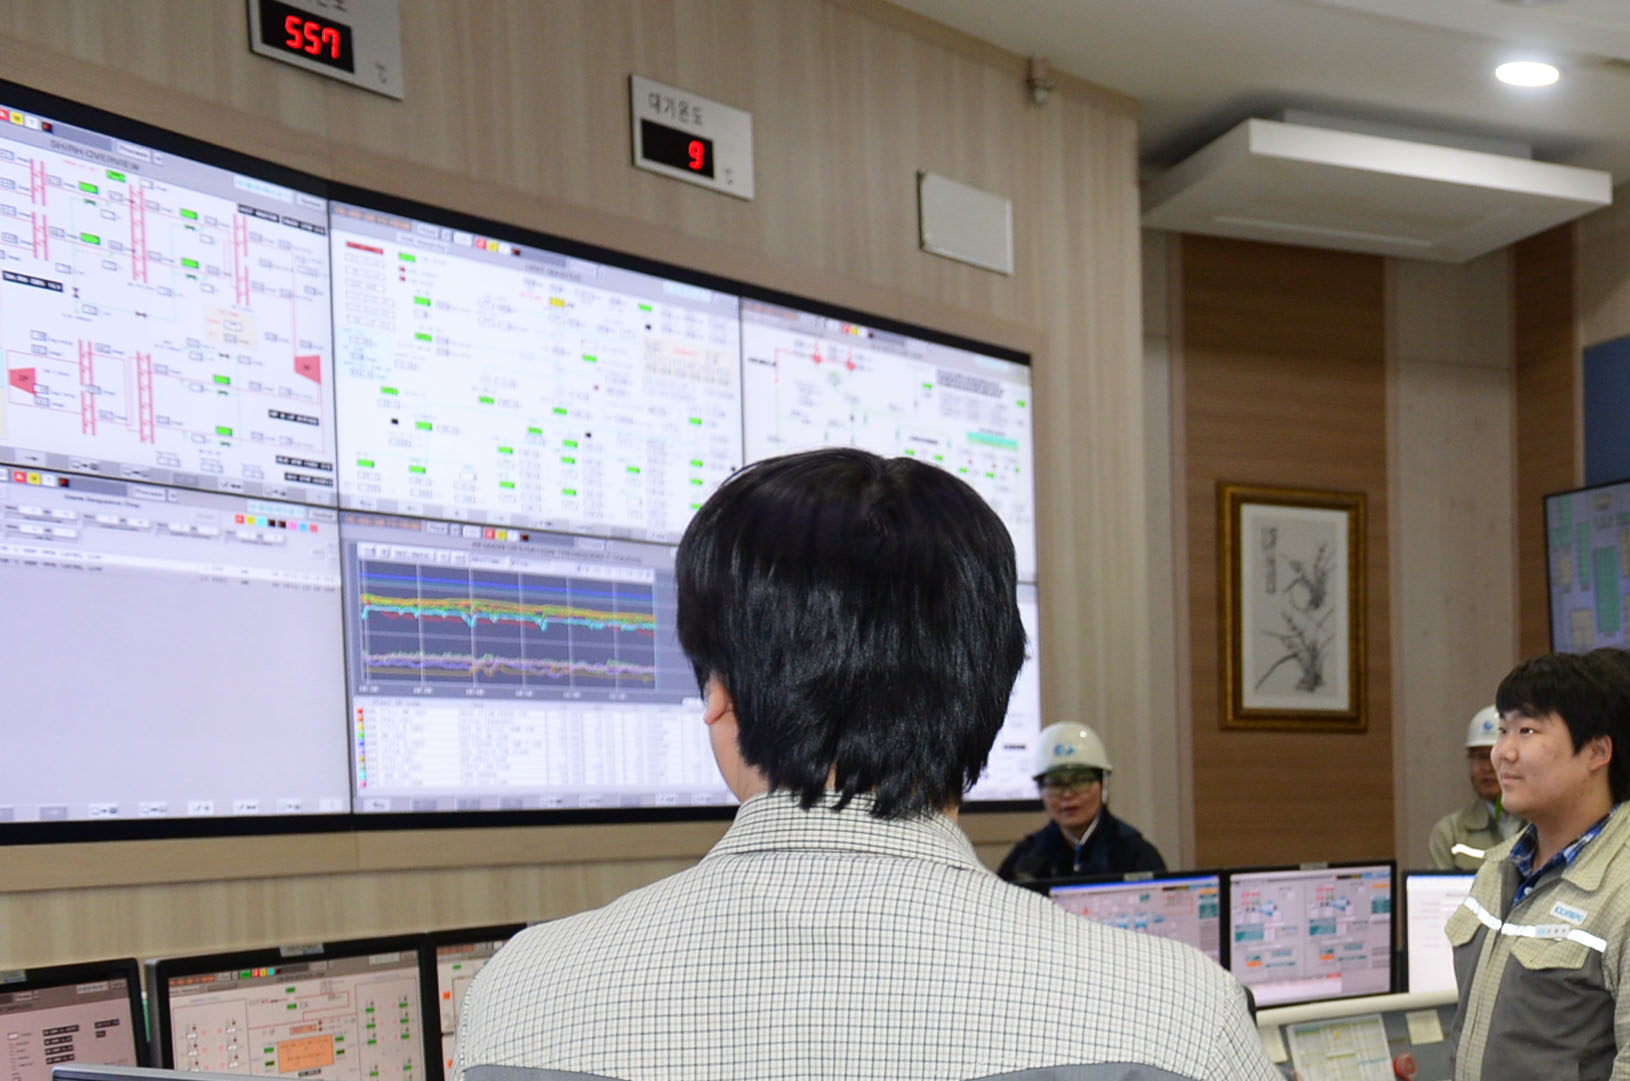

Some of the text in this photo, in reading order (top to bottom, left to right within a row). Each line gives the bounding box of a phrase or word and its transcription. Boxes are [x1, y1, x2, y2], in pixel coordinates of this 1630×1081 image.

[285, 15, 340, 60] 557
[647, 91, 703, 125] 대기온도
[688, 140, 704, 170] 9
